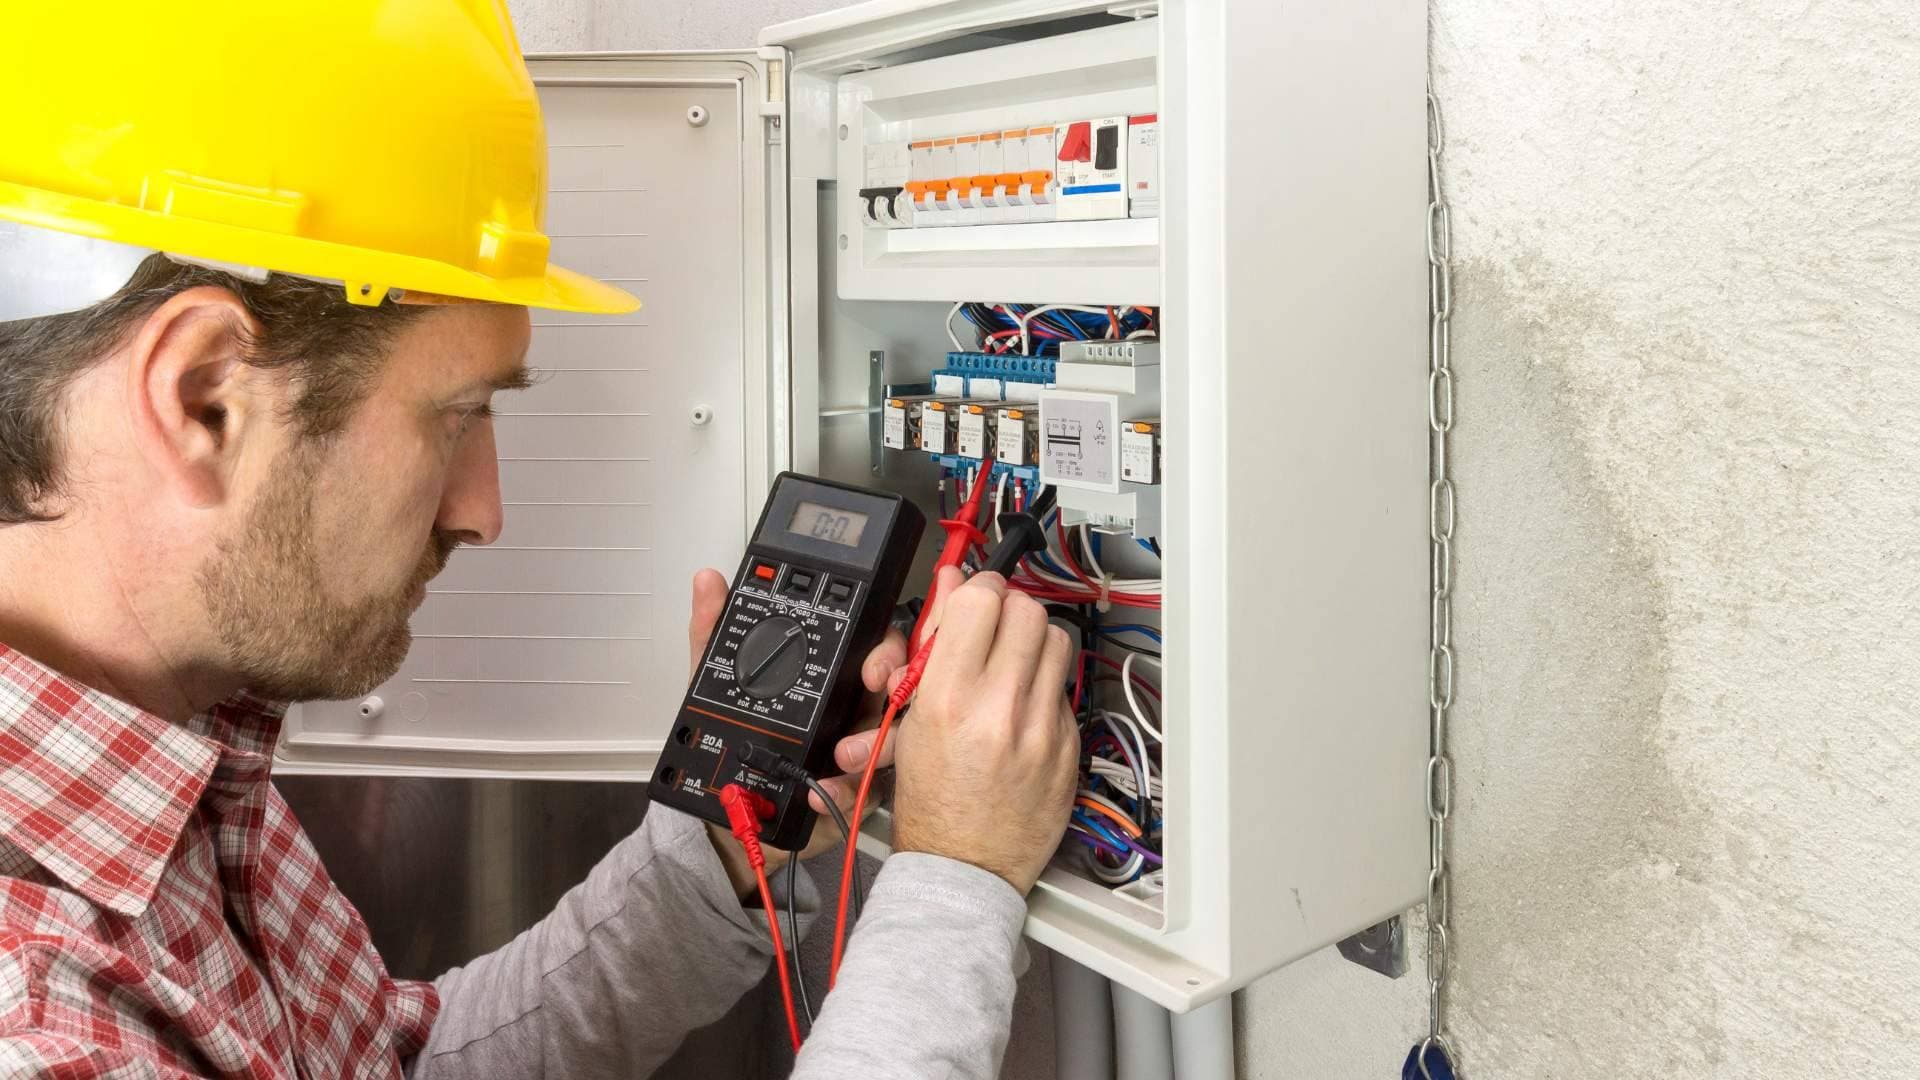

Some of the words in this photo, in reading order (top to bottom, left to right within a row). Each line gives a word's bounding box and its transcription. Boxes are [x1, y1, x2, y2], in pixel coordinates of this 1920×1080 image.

[735, 596, 743, 606] A
[795, 609, 811, 617] 1000
[735, 613, 753, 623] 200m
[806, 618, 819, 626] 200
[729, 626, 742, 635] 20m
[835, 621, 843, 631] V
[811, 633, 821, 641] 20
[809, 663, 827, 674] 200m
[718, 672, 731, 680] 200
[789, 693, 805, 702] 20M
[737, 699, 750, 708] 20K
[772, 702, 784, 711] 2M
[753, 704, 770, 713] 200K
[685, 778, 702, 789] mA
